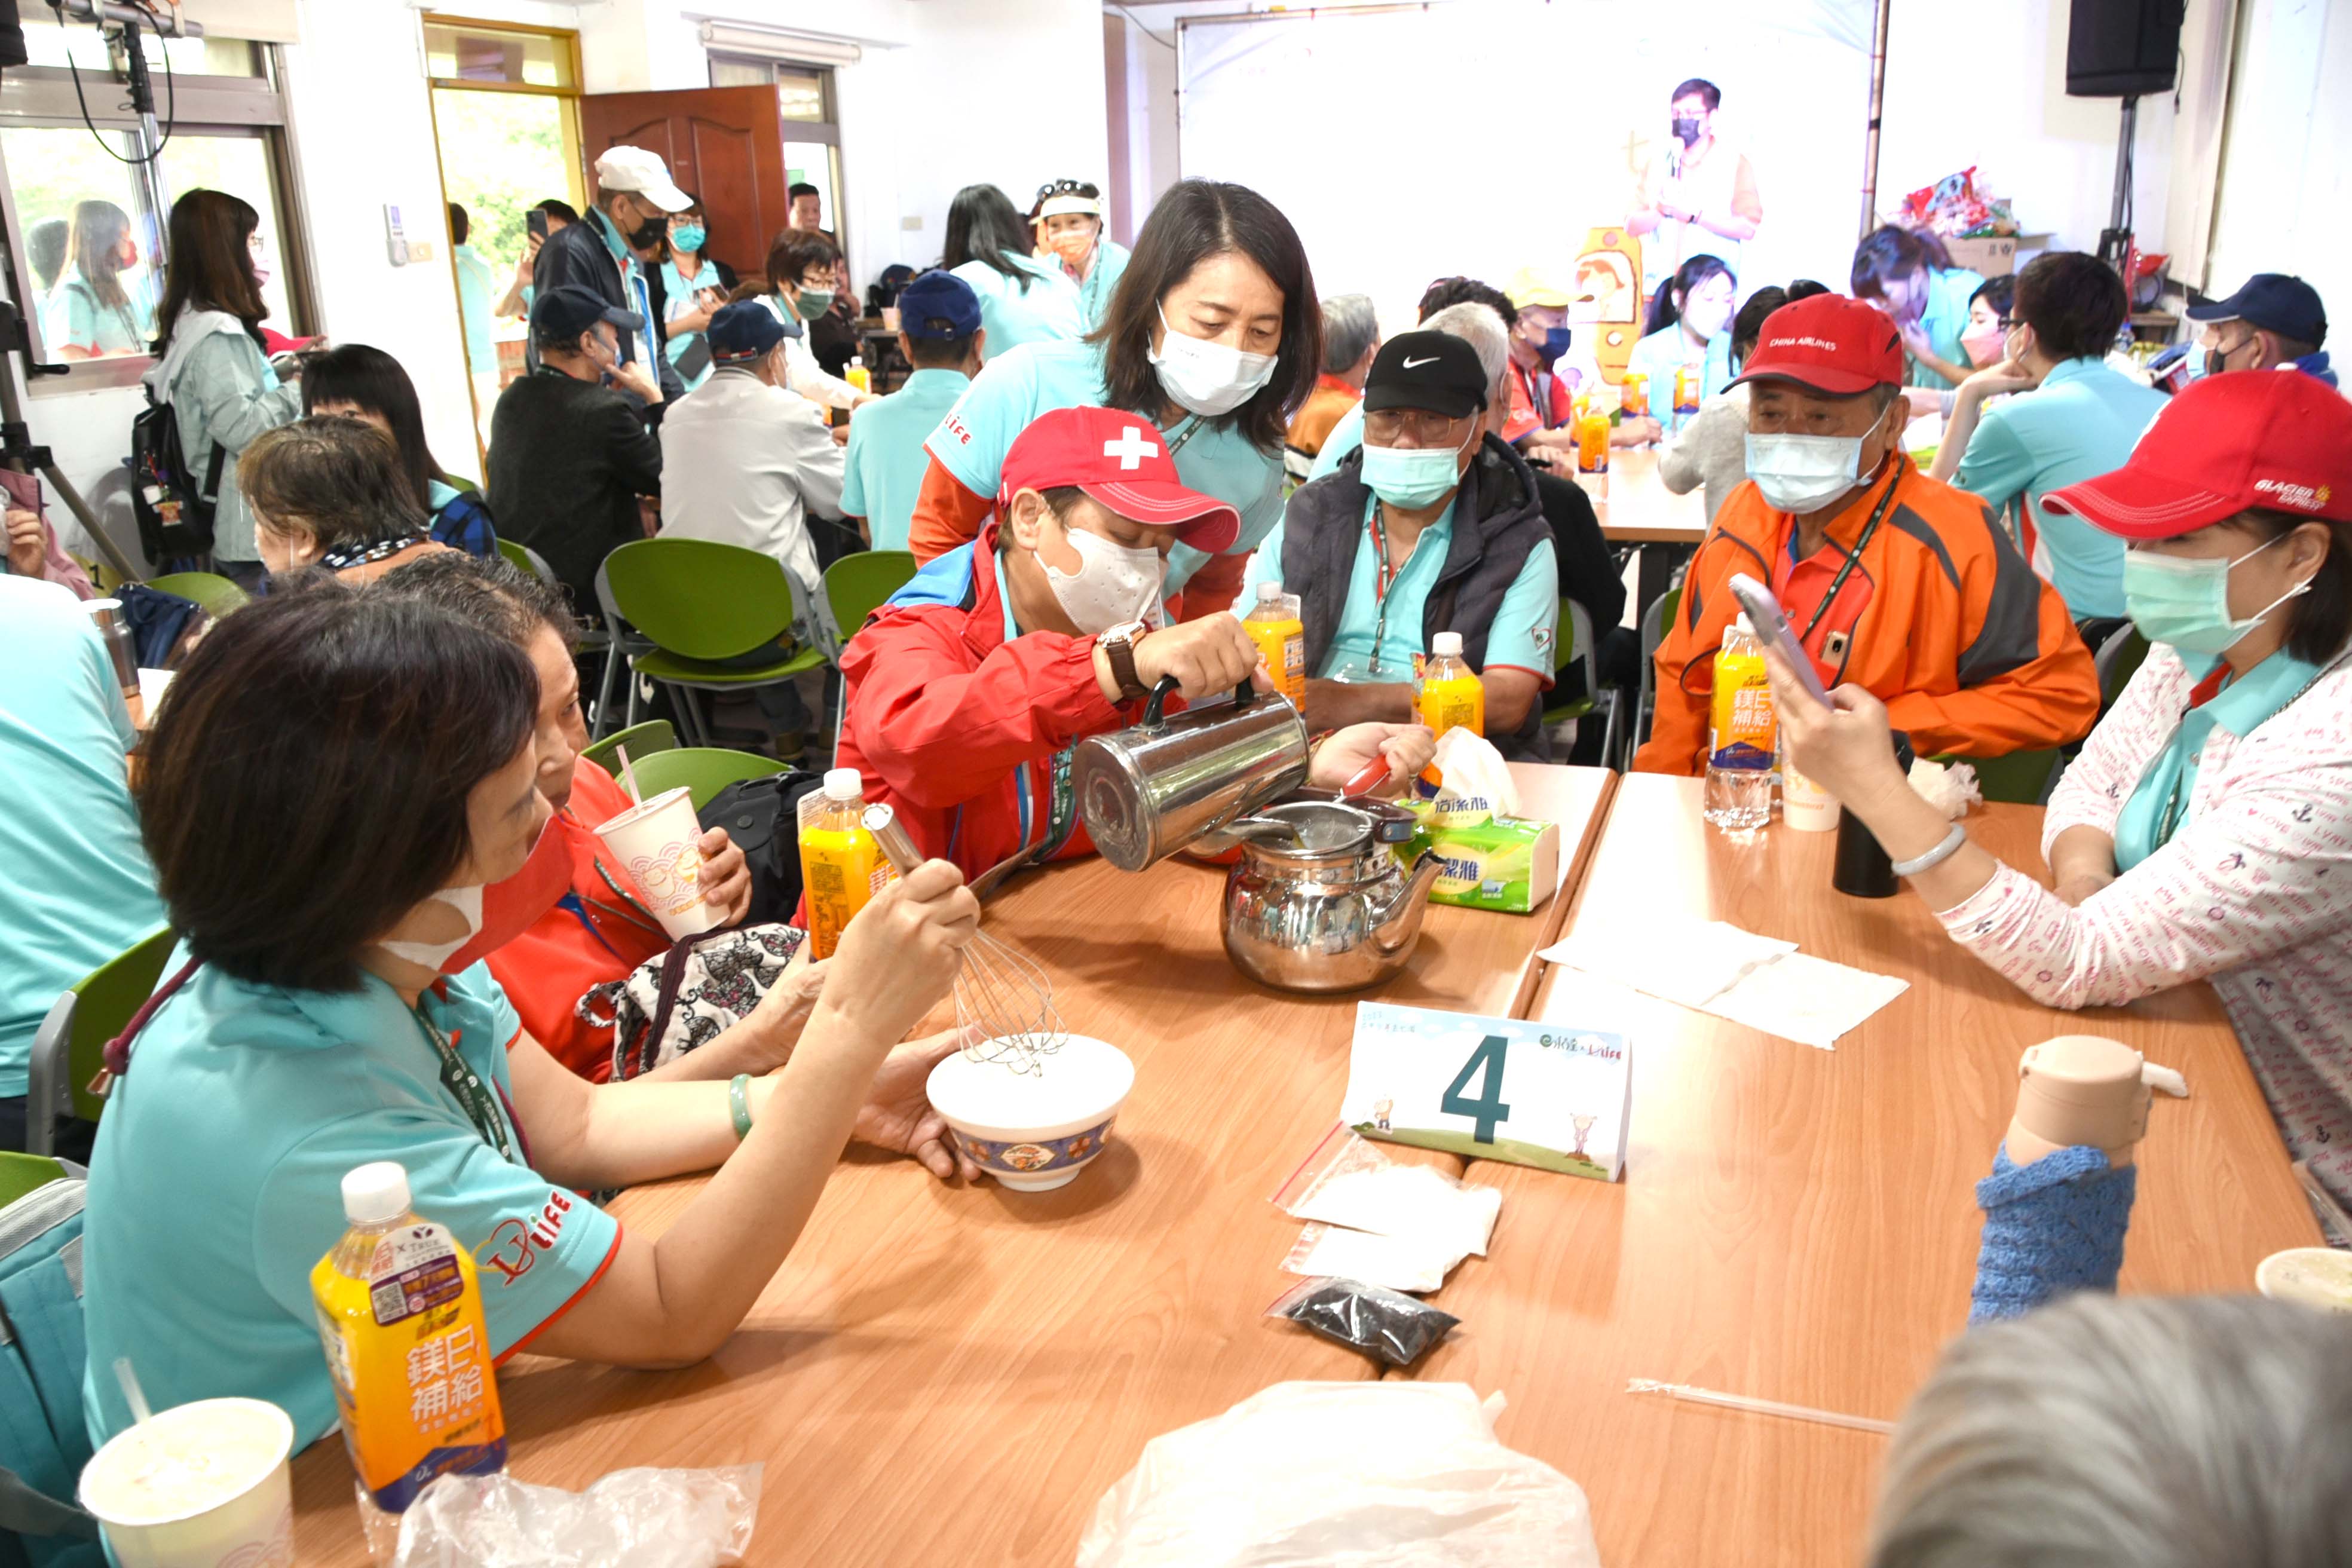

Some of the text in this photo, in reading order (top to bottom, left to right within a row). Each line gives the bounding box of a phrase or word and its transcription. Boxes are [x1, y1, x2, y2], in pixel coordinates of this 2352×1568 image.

[1769, 336, 1836, 351] CHINA AIRLINES
[2254, 479, 2314, 498] GLACIER
[89, 564, 105, 590] 1
[1440, 1035, 1511, 1145] 4
[411, 1364, 483, 1422] 補給
